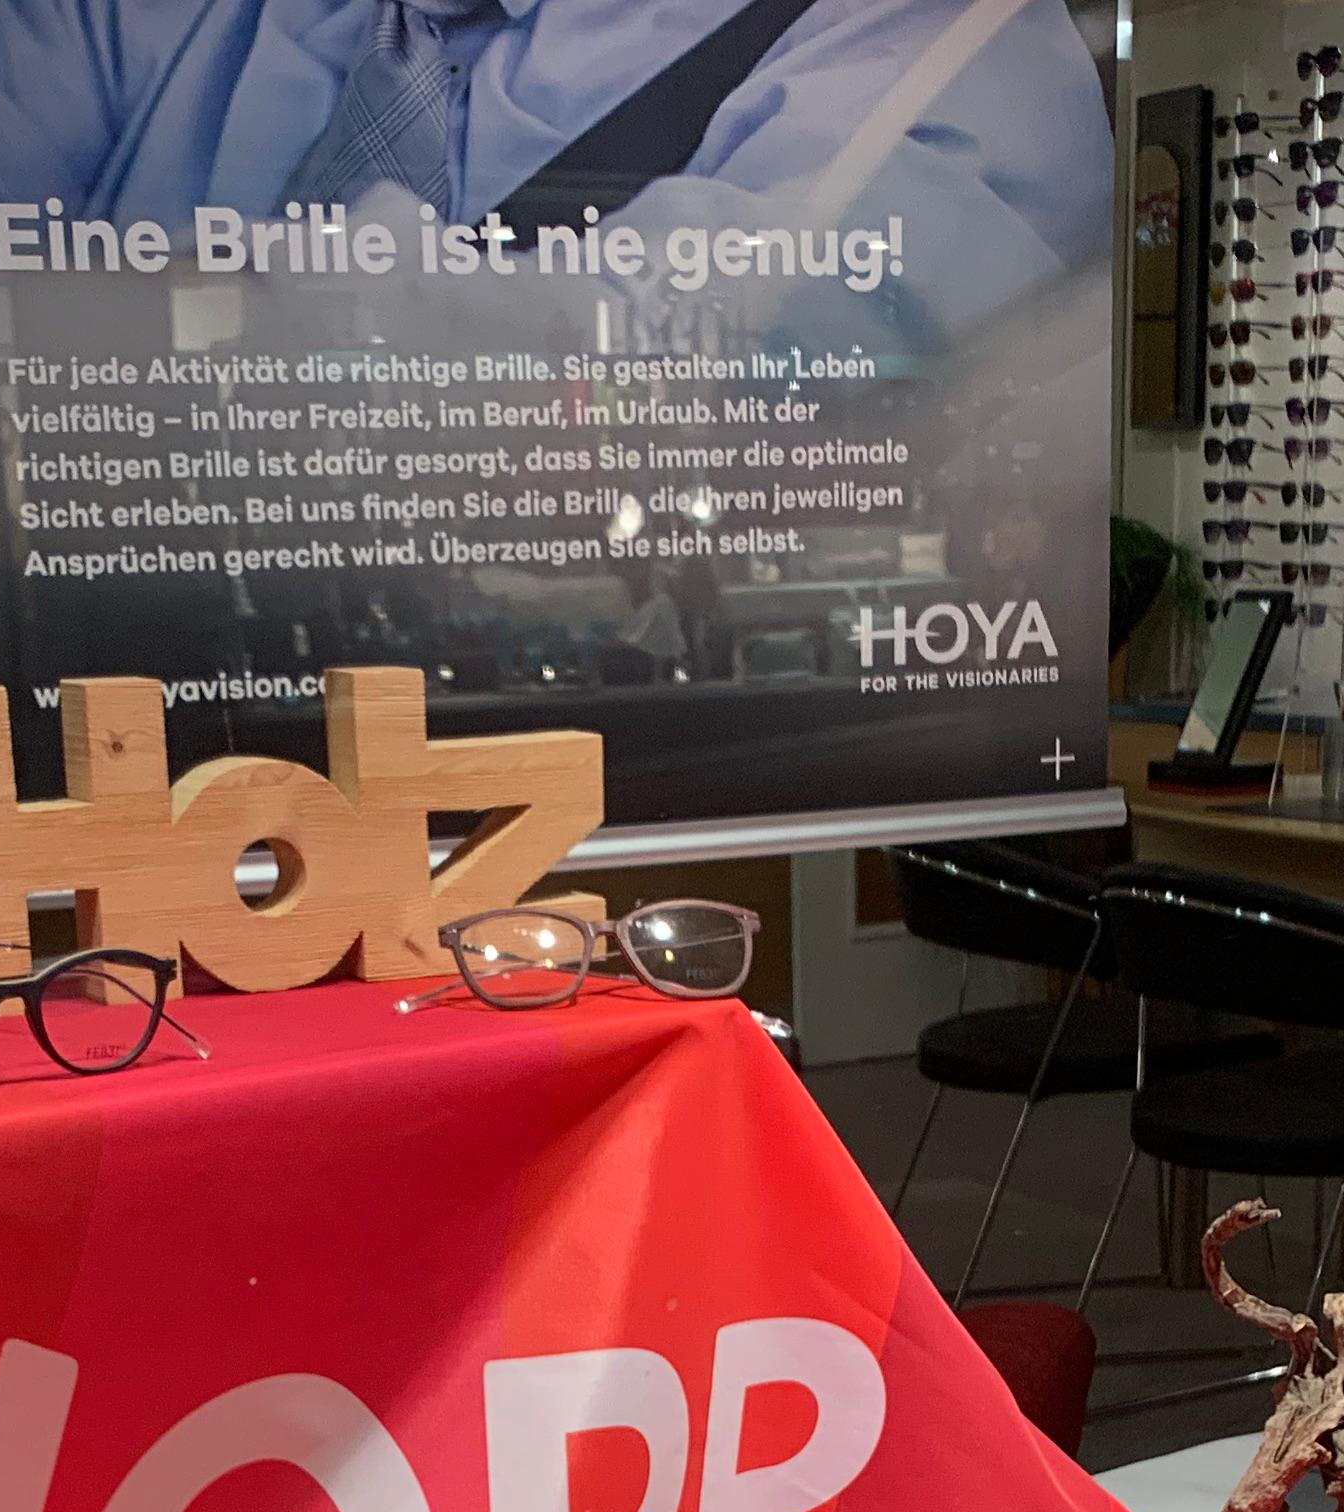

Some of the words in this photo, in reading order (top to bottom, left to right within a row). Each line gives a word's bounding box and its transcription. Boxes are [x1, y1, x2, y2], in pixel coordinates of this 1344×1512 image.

[194, 201, 398, 274] Brille
[419, 203, 517, 276] ist
[537, 205, 647, 275] nie
[665, 216, 903, 293] genug!
[8, 356, 62, 385] Für
[70, 356, 138, 390] jede
[147, 355, 289, 384] Aktivität
[297, 355, 343, 383] die
[351, 355, 468, 387] richtige
[475, 354, 556, 382] Brille.
[563, 354, 607, 382] Sie
[614, 354, 745, 386] gestalten
[752, 353, 788, 379] Ihr
[794, 352, 876, 379] Leben
[11, 403, 155, 438] vielfältig
[190, 401, 220, 431] in
[227, 402, 302, 430] Ihrer
[309, 400, 433, 432] Freizeit,
[439, 400, 477, 428] im
[482, 399, 569, 430] Beruf,
[574, 398, 610, 426] im
[616, 397, 718, 425] Urlaub.
[724, 397, 769, 423] Mit
[774, 395, 821, 423] der
[15, 451, 162, 486] richtigen
[169, 450, 251, 479] Brille
[258, 449, 298, 477] ist
[304, 448, 389, 475] dafür
[395, 446, 518, 480] gesorgt,
[524, 445, 592, 472] dass
[599, 442, 641, 470] Sie
[648, 441, 738, 468] immer
[744, 440, 785, 467] die
[791, 438, 908, 470] optimale
[20, 500, 105, 529] Sicht
[111, 497, 239, 528] erleben.
[245, 494, 294, 524] Bei
[301, 499, 355, 522] uns
[363, 492, 456, 520] finden
[463, 490, 507, 518] Sie
[514, 488, 557, 517] die
[649, 485, 692, 513] die
[772, 481, 904, 515] jeweiligen
[23, 545, 217, 580] Ansprüchen
[223, 540, 345, 576] gerecht
[351, 538, 425, 566] wird.
[430, 531, 602, 566] Überzeugen
[608, 534, 650, 559] Sie
[657, 529, 712, 556] sich
[719, 527, 806, 554] selbst.
[849, 600, 1058, 667] HOYA
[860, 675, 898, 693] FOR
[904, 672, 939, 691] THE
[946, 667, 1060, 688] VISIONARIES
